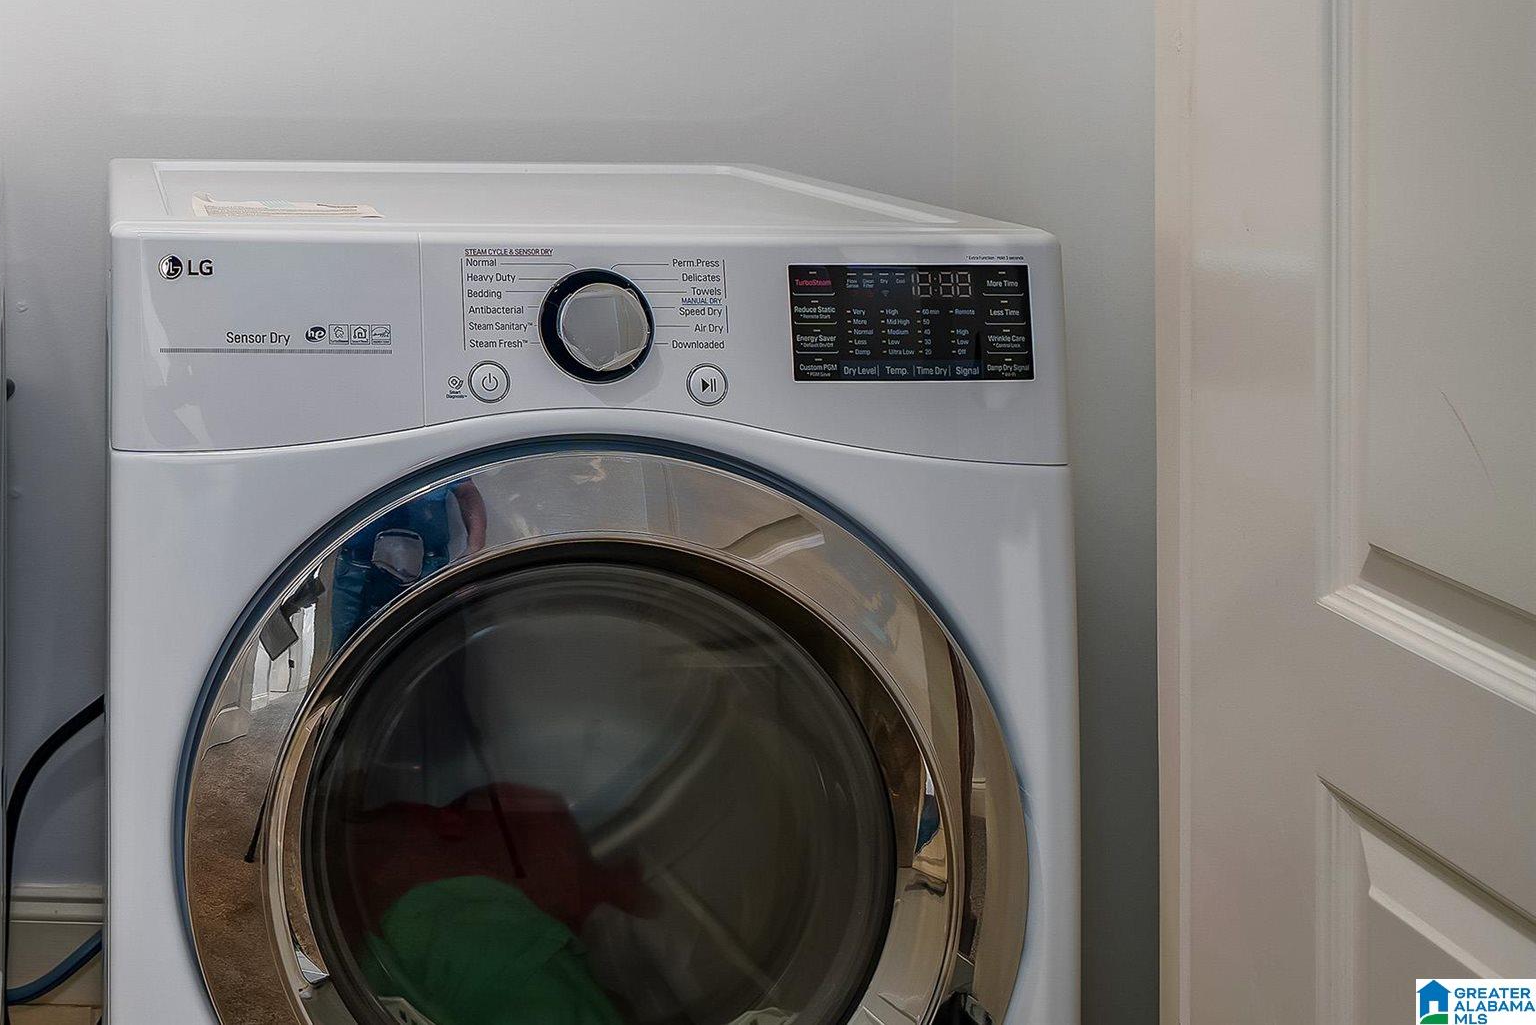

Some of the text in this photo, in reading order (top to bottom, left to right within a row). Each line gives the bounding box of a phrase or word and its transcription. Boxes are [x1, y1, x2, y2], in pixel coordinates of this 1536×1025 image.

[465, 258, 497, 267] Normal
[188, 260, 213, 276] LG
[466, 273, 516, 283] Heavy Duty
[681, 273, 721, 282] Delicates
[794, 279, 832, 287] TurboSteam
[467, 289, 502, 300] Bedding
[690, 286, 722, 296] Towels
[468, 306, 524, 315] Antibacterial
[679, 307, 723, 317] Speed Dry
[468, 322, 494, 331] Steam
[694, 324, 724, 334] Air Dry
[226, 331, 291, 346] Sensor Dry
[469, 339, 497, 348] Steam
[796, 335, 818, 343] Energy
[672, 340, 725, 349] Downloaded
[843, 366, 876, 376] Dry Level
[885, 366, 909, 376] Temp.
[916, 366, 948, 376] Time Dry
[955, 366, 980, 376] Signal
[987, 364, 1030, 372] Damp Dry Signal
